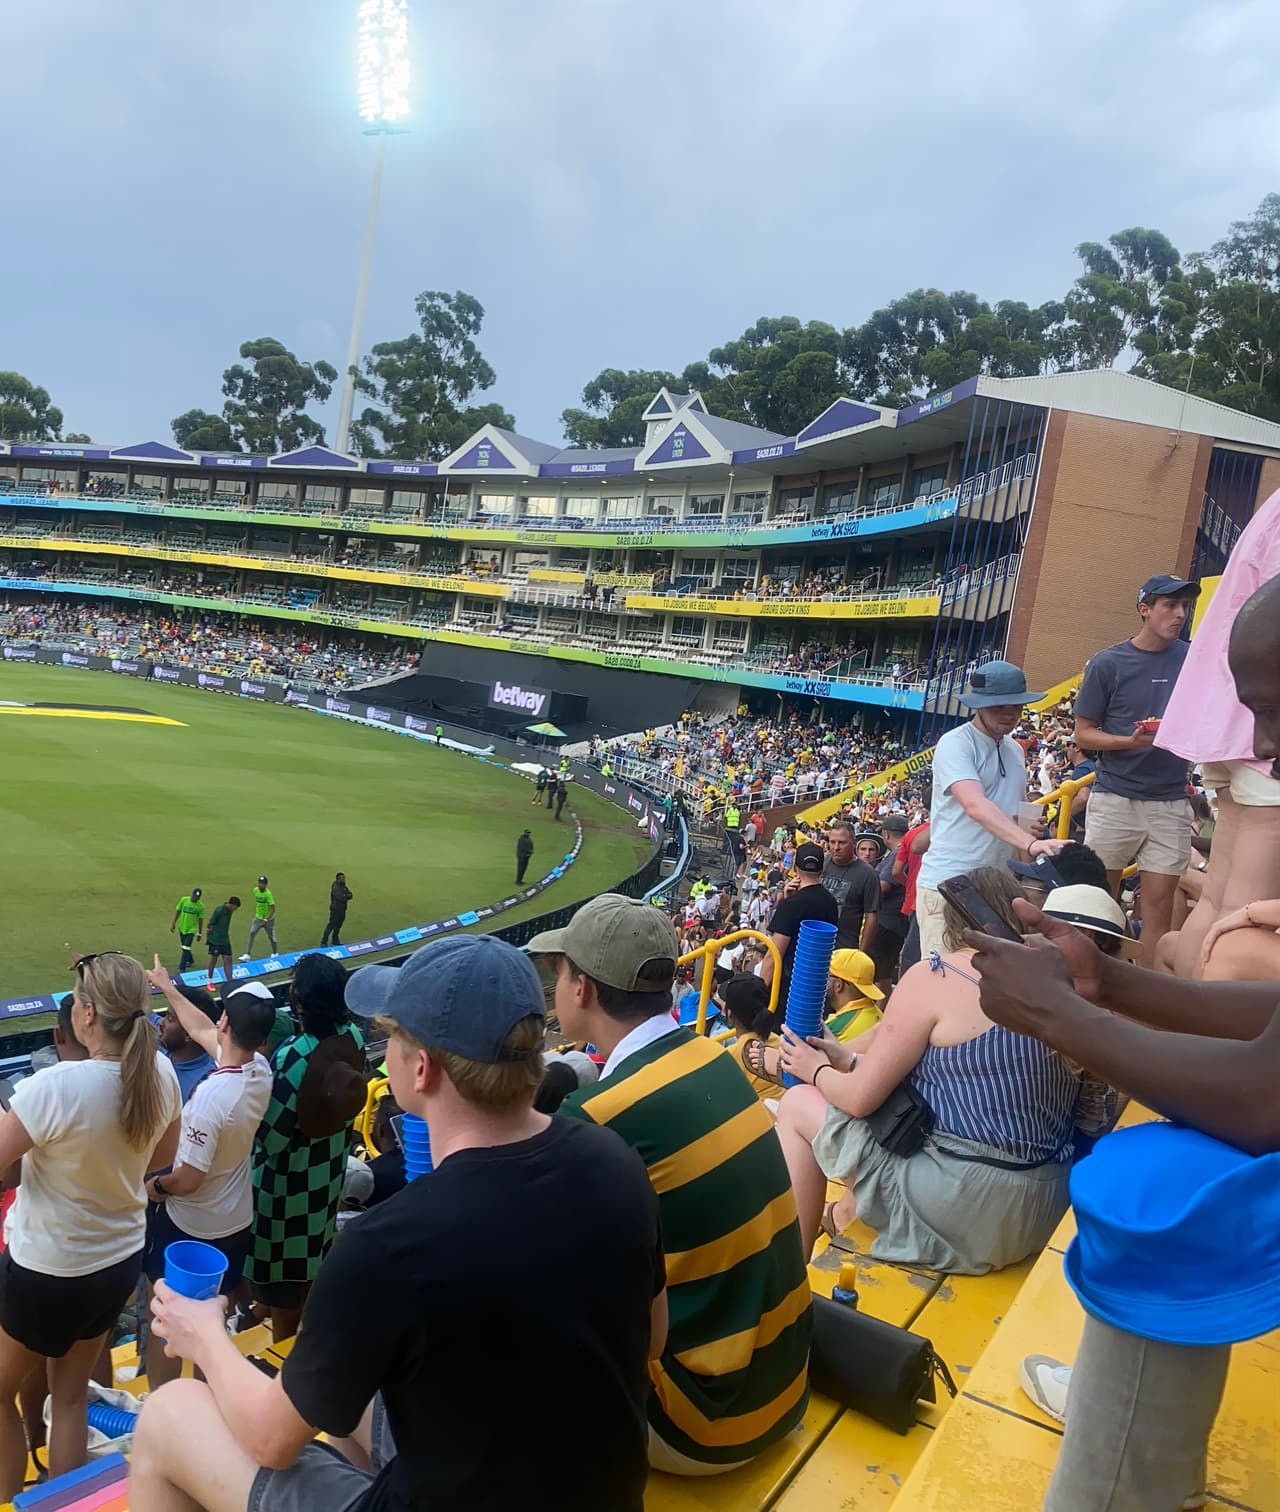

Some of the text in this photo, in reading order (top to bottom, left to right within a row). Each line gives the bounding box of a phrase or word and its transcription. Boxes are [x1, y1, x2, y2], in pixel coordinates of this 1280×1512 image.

[756, 446, 783, 459] SA20.CO.ZA
[811, 521, 859, 539] betway SA20
[786, 680, 803, 692] betway
[816, 681, 831, 698] SA20
[493, 681, 546, 716] betway
[264, 959, 282, 972] rain
